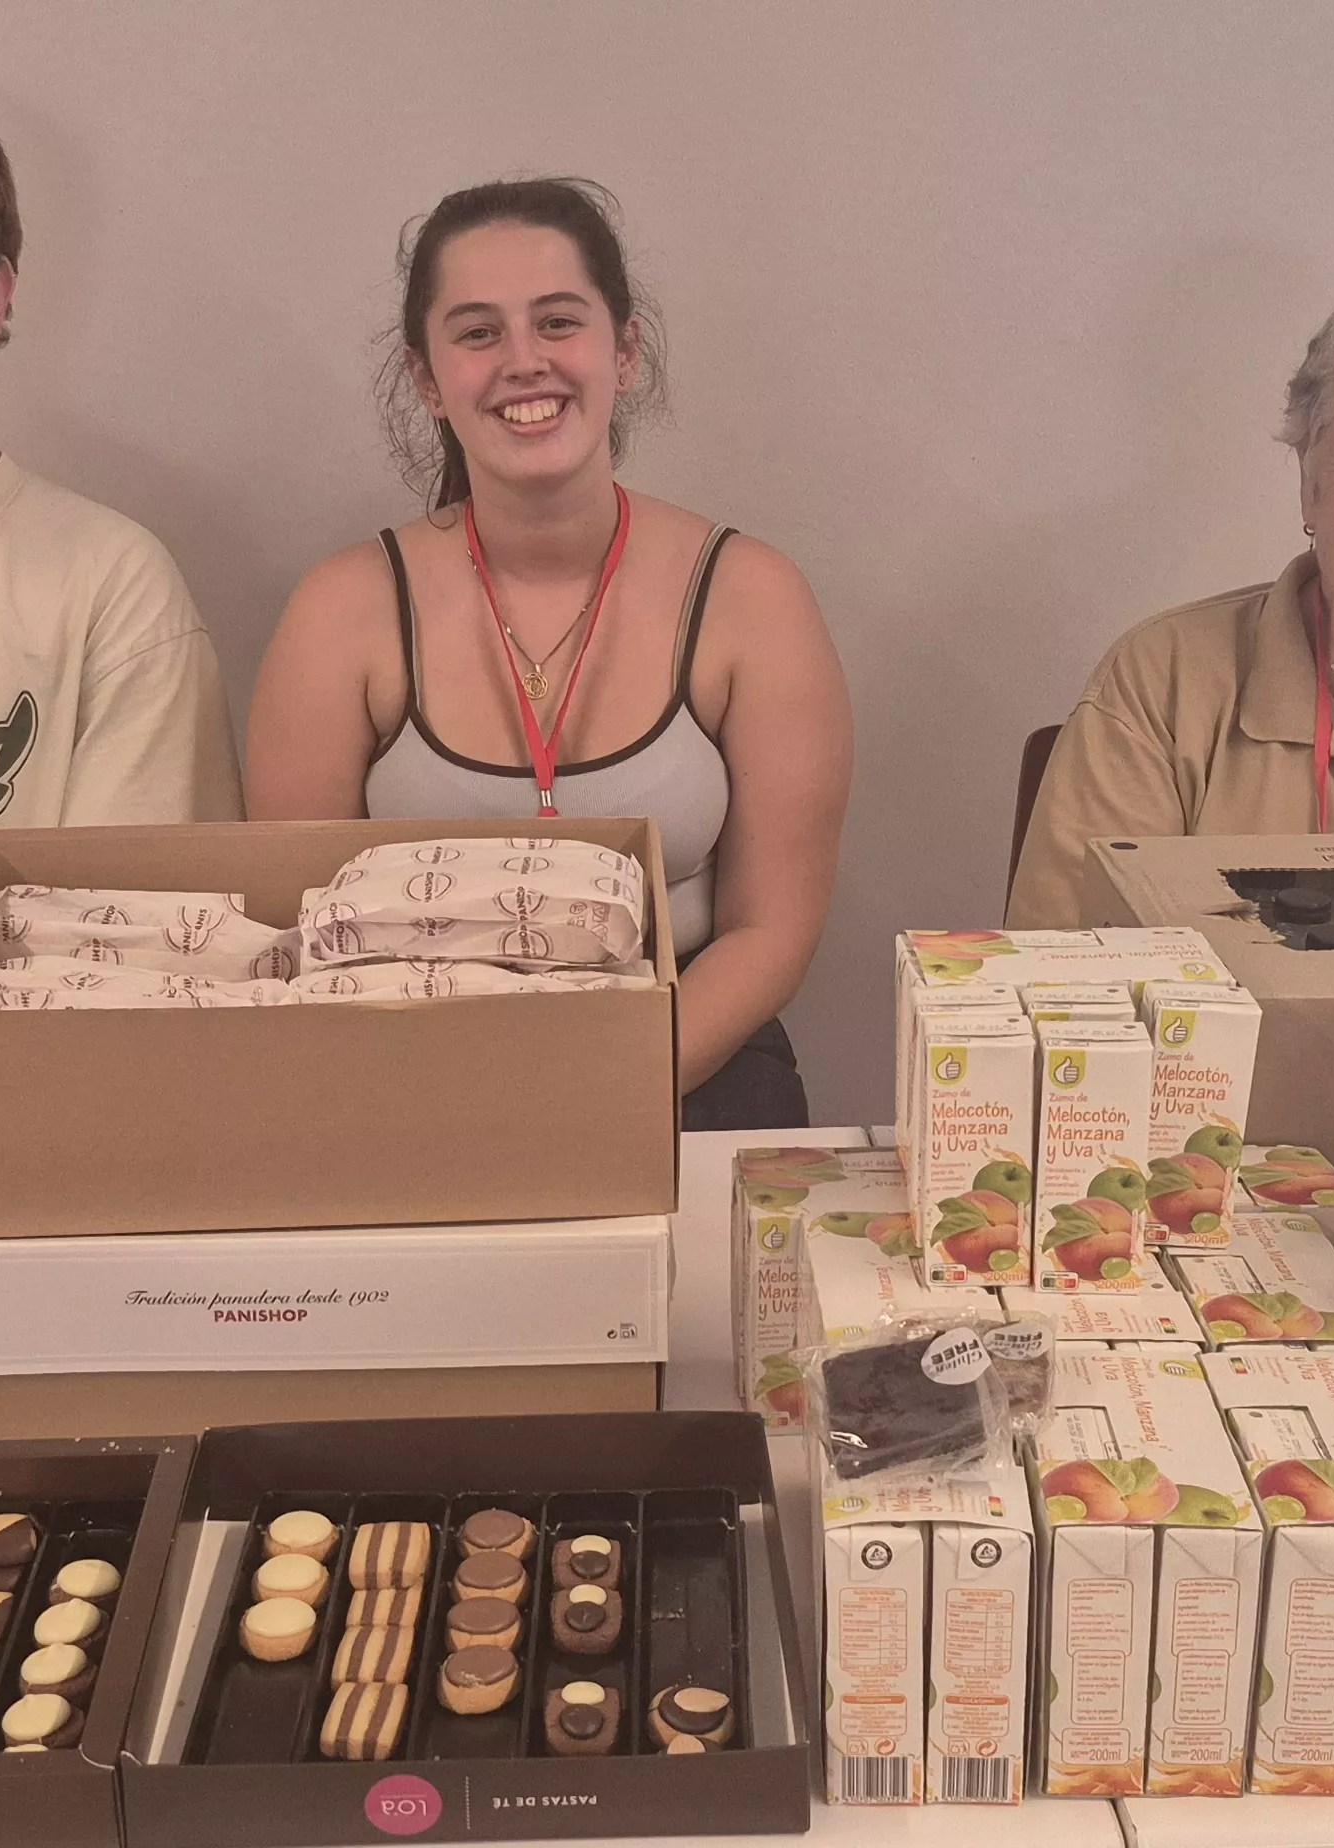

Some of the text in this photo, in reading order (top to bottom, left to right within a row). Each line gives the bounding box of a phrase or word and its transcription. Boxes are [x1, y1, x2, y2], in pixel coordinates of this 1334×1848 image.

[1157, 1051, 1195, 1062] Zumo de
[1154, 1063, 1233, 1086] Melocotón,
[931, 1087, 971, 1099] Zumo de
[1049, 1091, 1088, 1103] Zumo de
[1152, 1083, 1227, 1101] Manzana
[931, 1100, 1013, 1121] Melocotón,
[1047, 1103, 1131, 1127] Melocotón,
[1149, 1099, 1195, 1120] y Uva
[931, 1120, 1009, 1137] Manzana
[1046, 1126, 1125, 1143] Manzana
[931, 1136, 978, 1160] y Uva
[1046, 1141, 1094, 1165] y Uva
[758, 1265, 799, 1285] Meloc
[124, 1287, 390, 1311] Tradición panadera desde 1902
[758, 1286, 801, 1301] Manz
[213, 1308, 309, 1323] PANISHOP
[758, 1302, 768, 1321] y
[994, 1331, 1044, 1343] FREE
[930, 1338, 980, 1365] FREE
[934, 1350, 984, 1374] Gluten
[1101, 1362, 1120, 1382] Uva
[1296, 1363, 1316, 1382] Uva
[1119, 1356, 1160, 1443] Melocotón, Manzana
[1089, 1748, 1122, 1762] 200ml
[1189, 1748, 1223, 1762] 200ml
[1300, 1748, 1333, 1762] 200ml
[515, 1796, 536, 1808] DE
[541, 1794, 598, 1807] PASTAS
